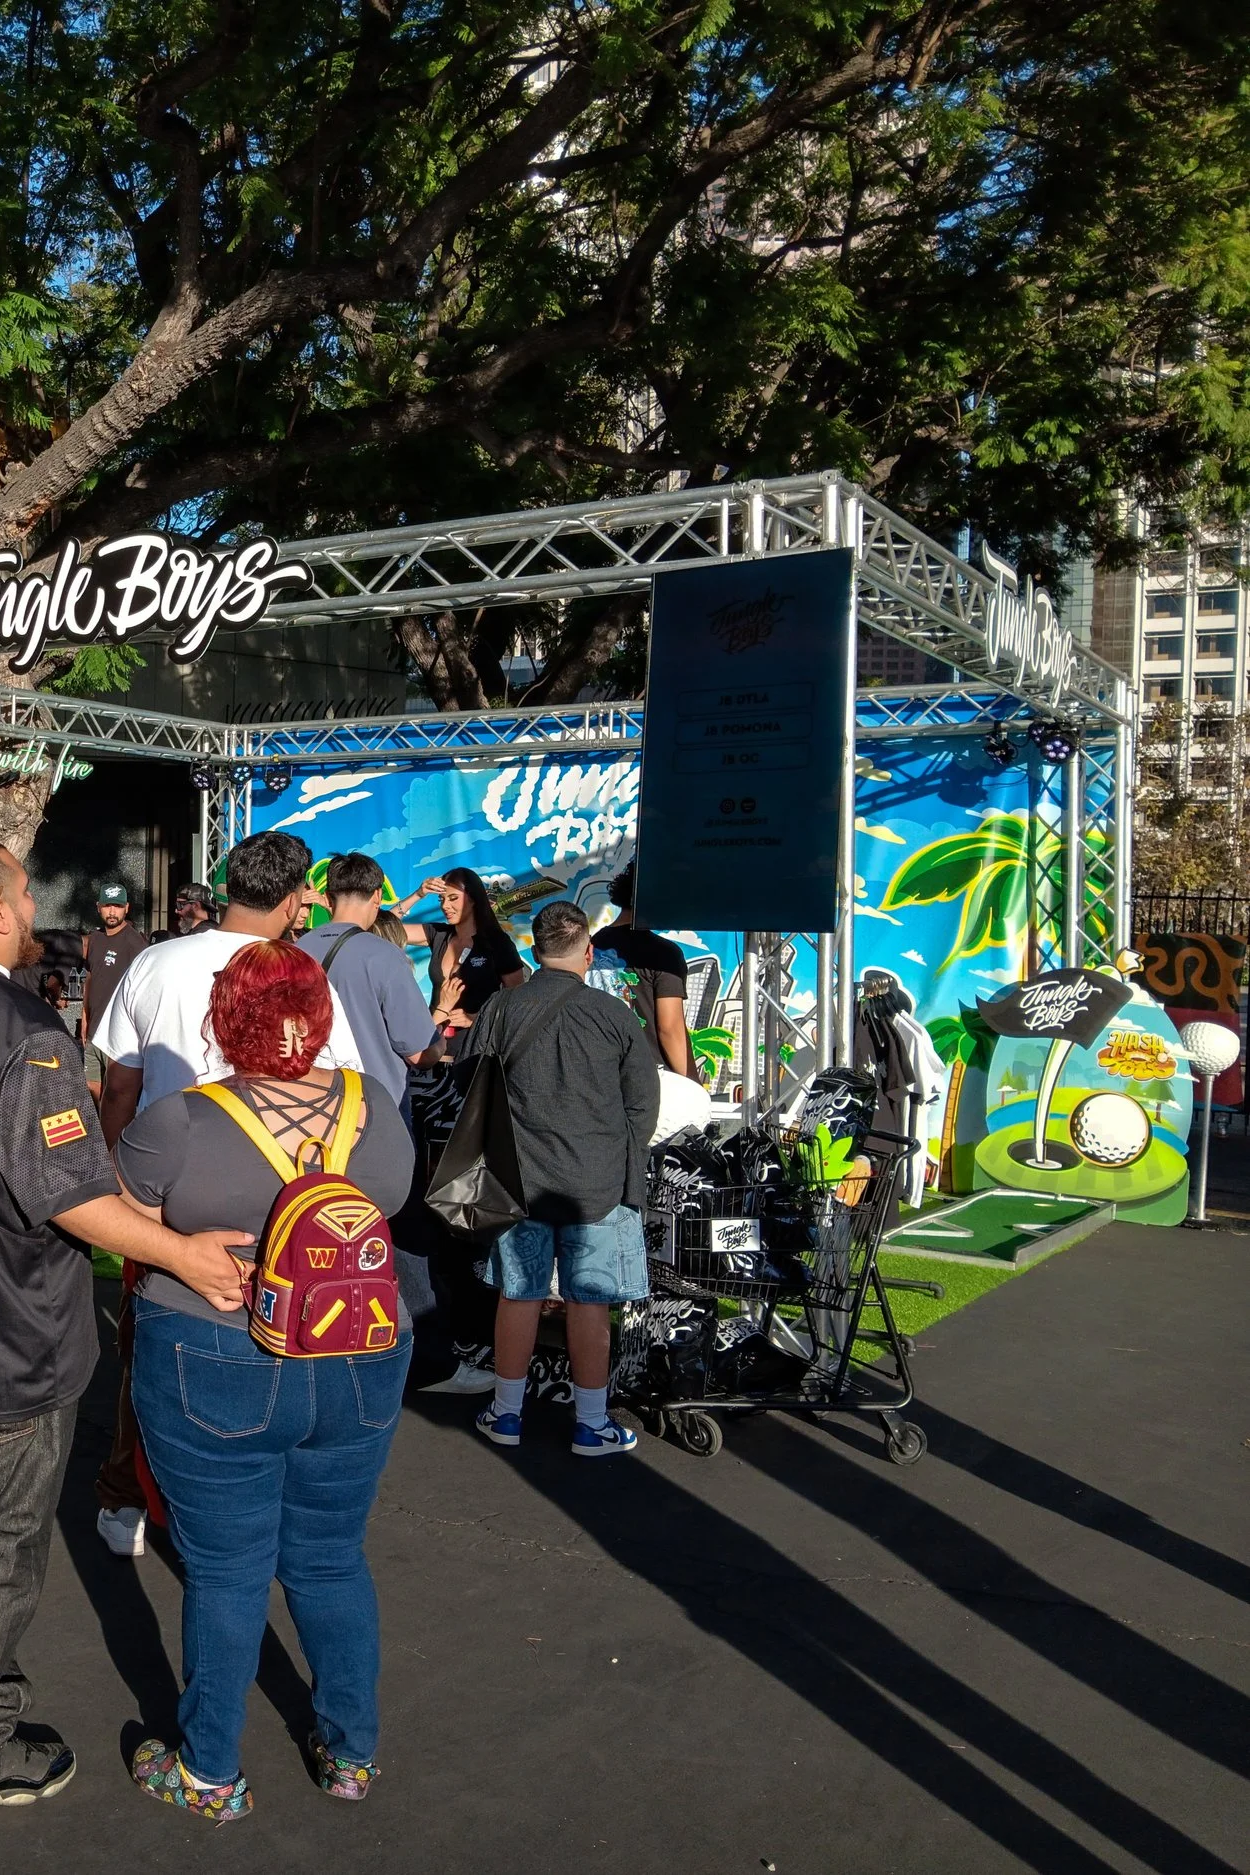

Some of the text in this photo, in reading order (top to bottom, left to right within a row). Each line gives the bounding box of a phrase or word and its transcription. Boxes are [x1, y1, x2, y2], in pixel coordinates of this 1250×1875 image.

[98, 534, 310, 657] Boys
[985, 546, 1078, 709] Jungle Boys
[722, 720, 783, 737] POMONA
[52, 742, 94, 794] fire
[1019, 975, 1103, 1009] Jungle
[1024, 1000, 1089, 1031] Boys
[715, 1220, 757, 1240] Jungle
[722, 1233, 754, 1250] Boys
